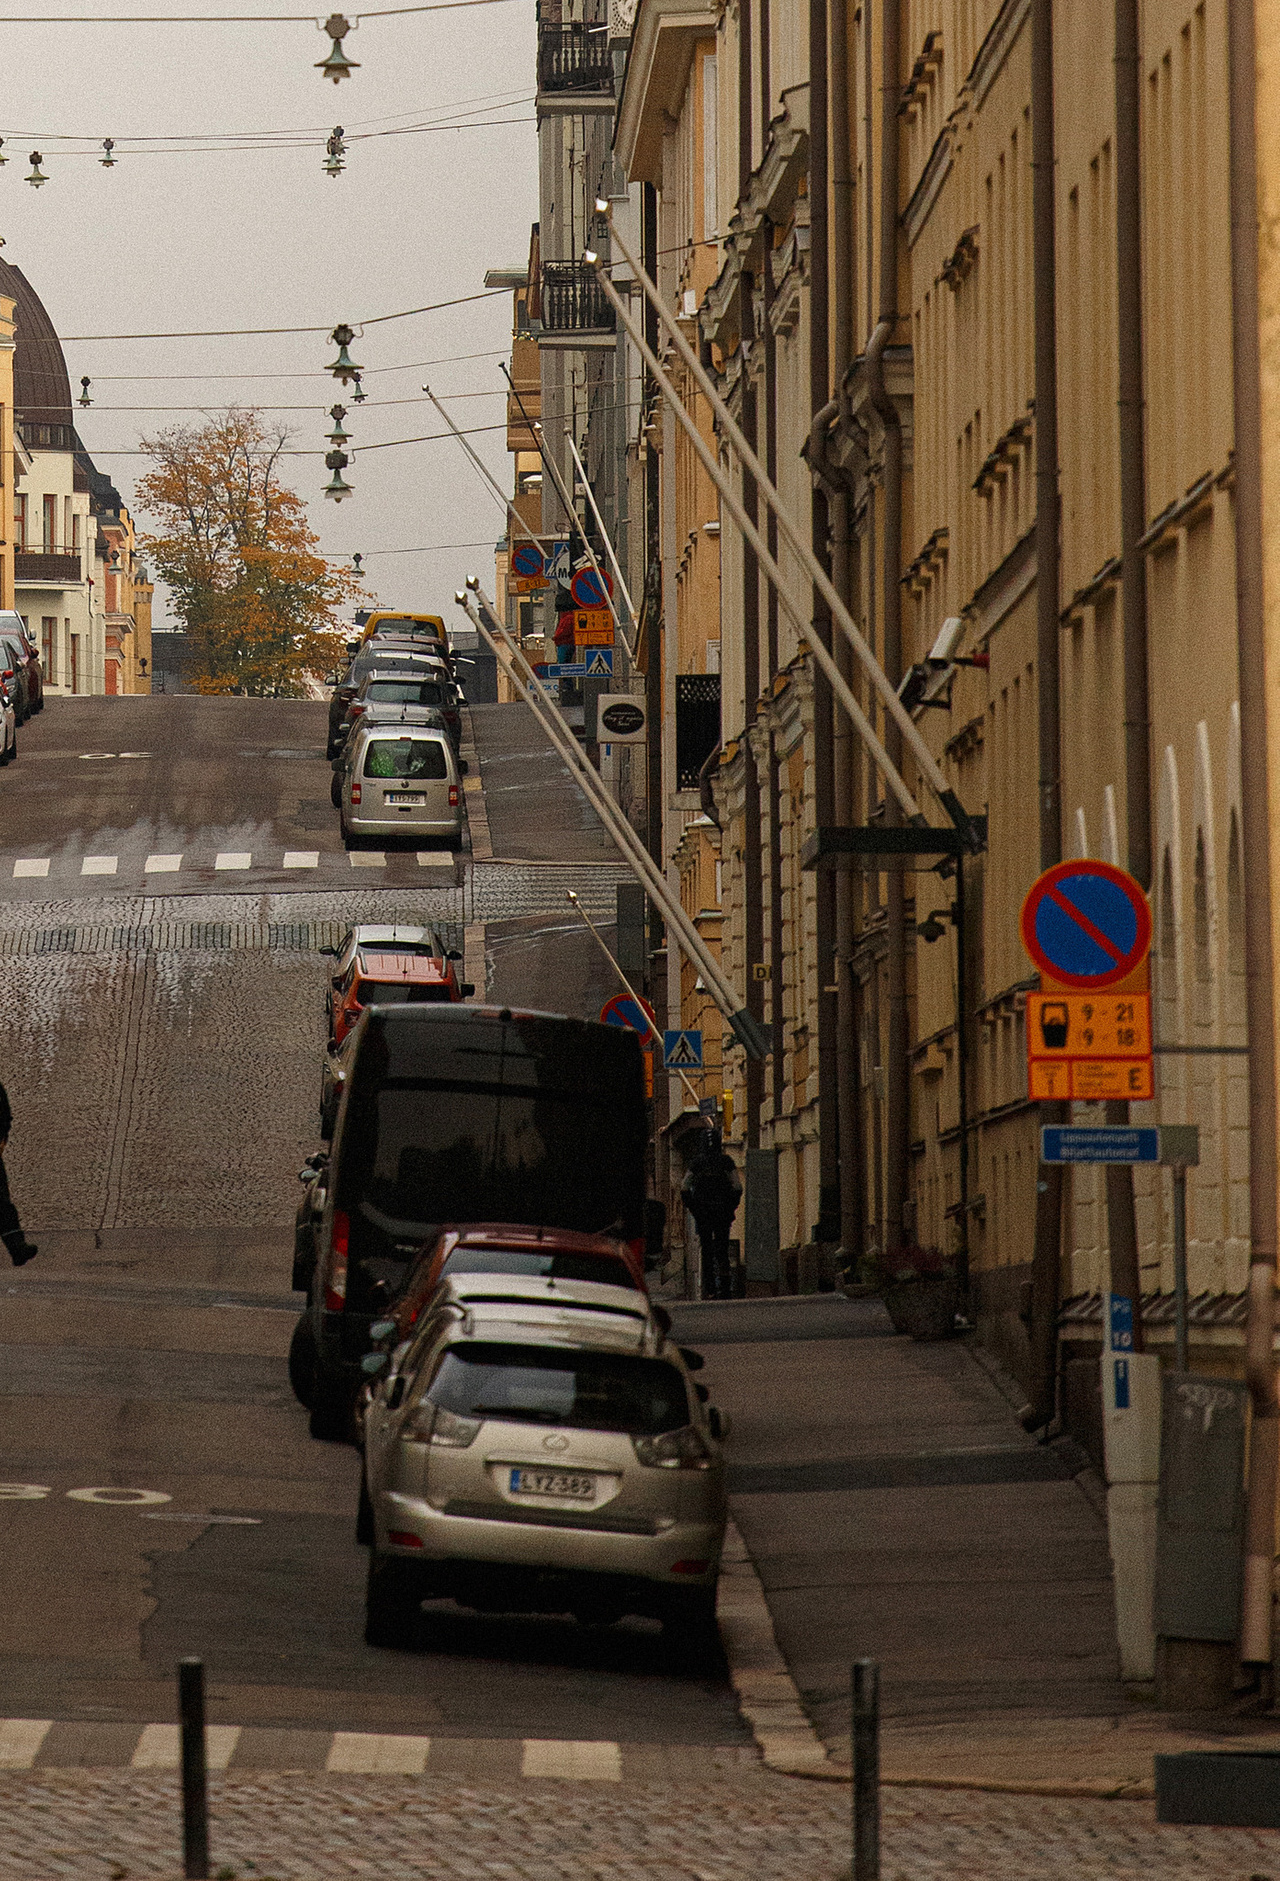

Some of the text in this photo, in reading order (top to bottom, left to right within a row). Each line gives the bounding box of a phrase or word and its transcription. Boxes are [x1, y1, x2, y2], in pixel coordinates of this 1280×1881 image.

[1081, 1003, 1094, 1021] 9
[1116, 1003, 1133, 1021] 21
[1129, 1067, 1142, 1091] E
